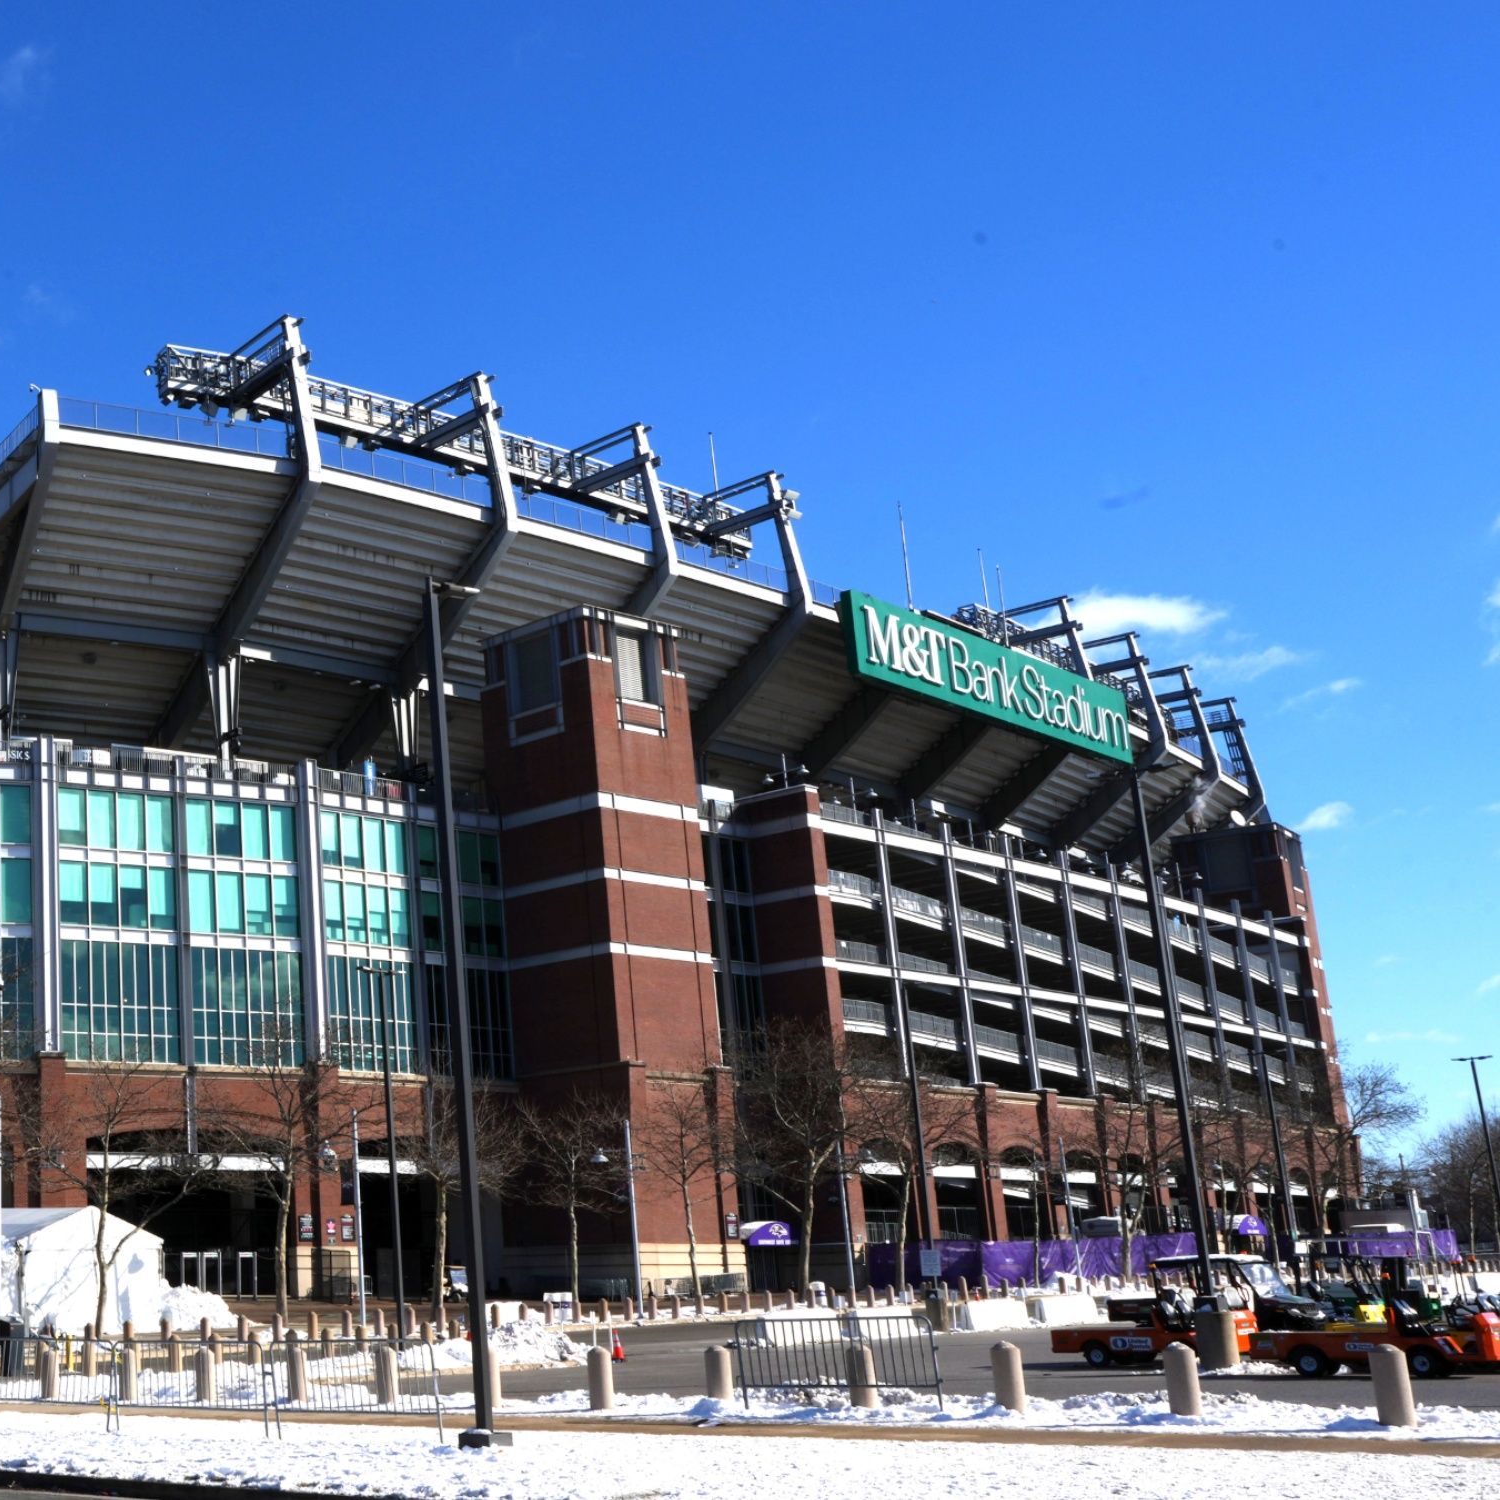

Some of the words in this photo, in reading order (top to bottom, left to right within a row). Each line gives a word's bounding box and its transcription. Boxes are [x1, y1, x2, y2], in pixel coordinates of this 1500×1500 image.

[863, 604, 945, 686] M&T
[948, 636, 1023, 713] Bank
[1020, 664, 1129, 750] Stadium
